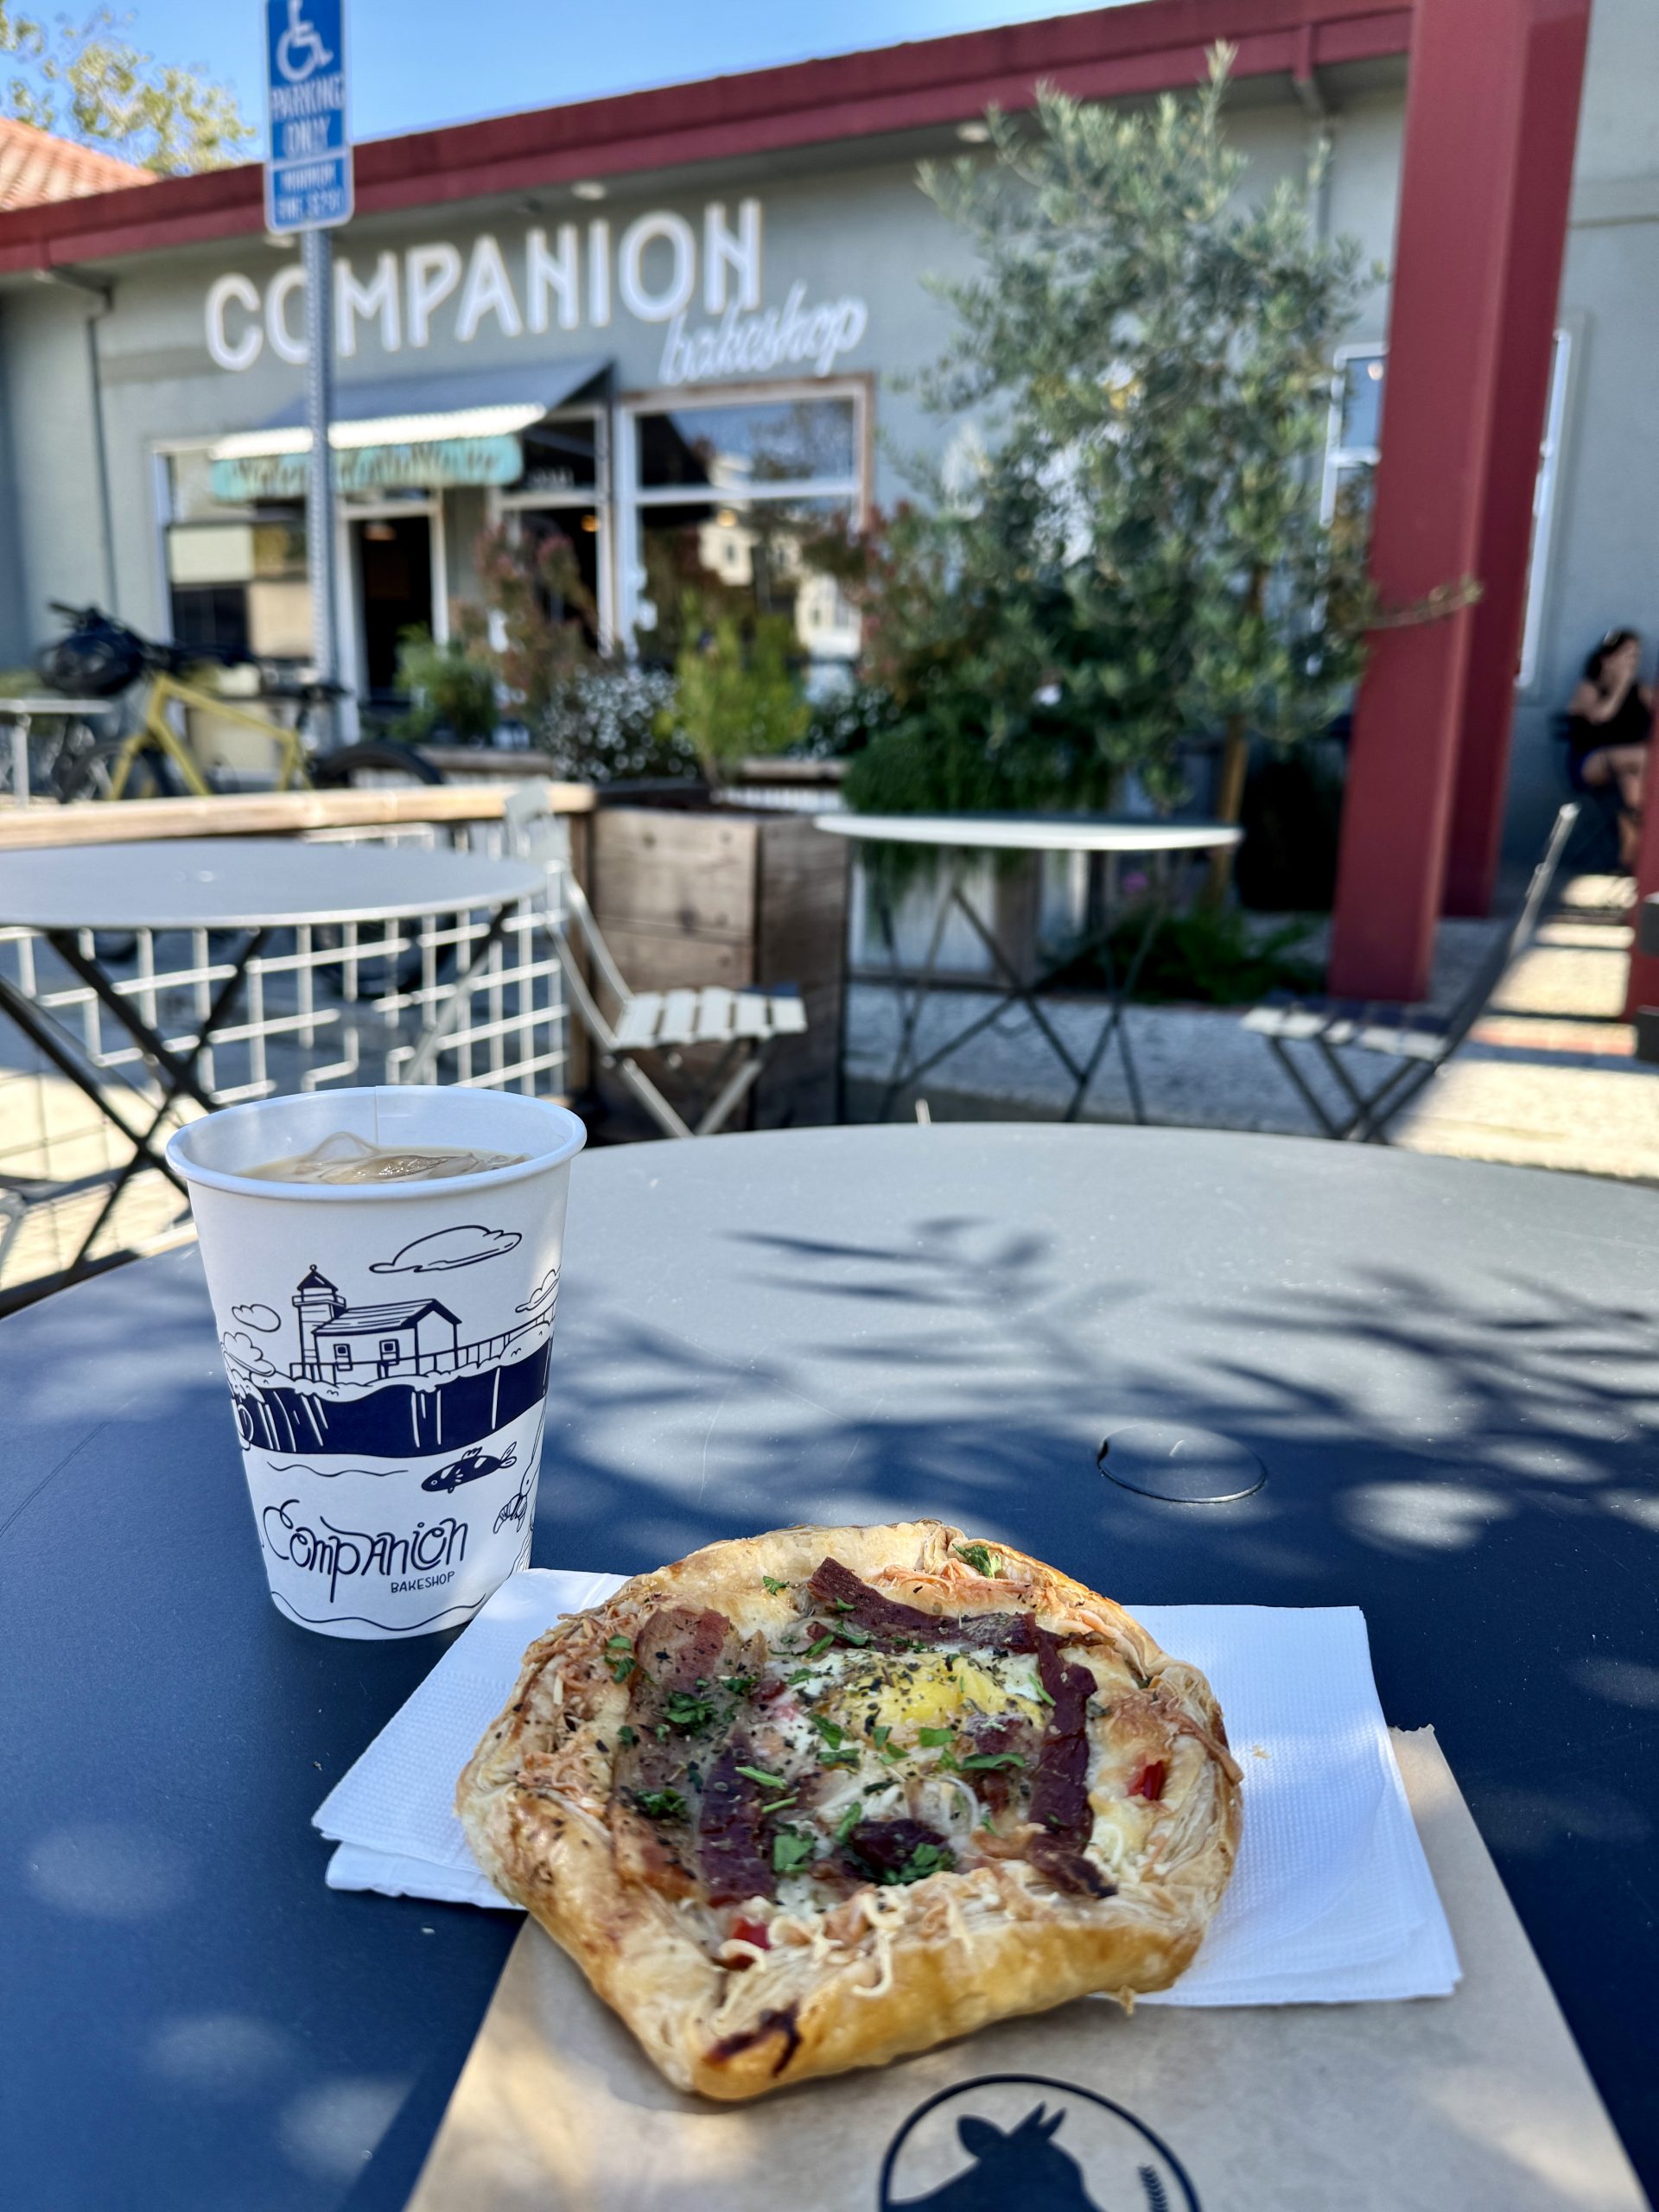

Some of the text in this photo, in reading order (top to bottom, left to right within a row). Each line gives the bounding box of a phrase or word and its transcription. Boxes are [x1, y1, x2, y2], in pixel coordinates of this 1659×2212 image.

[271, 75, 345, 120] PARKING
[283, 115, 331, 159] ONLY
[205, 198, 761, 372] COMPANION
[658, 279, 868, 385] bakeshop
[391, 1571, 455, 1594] BAKESHOP
